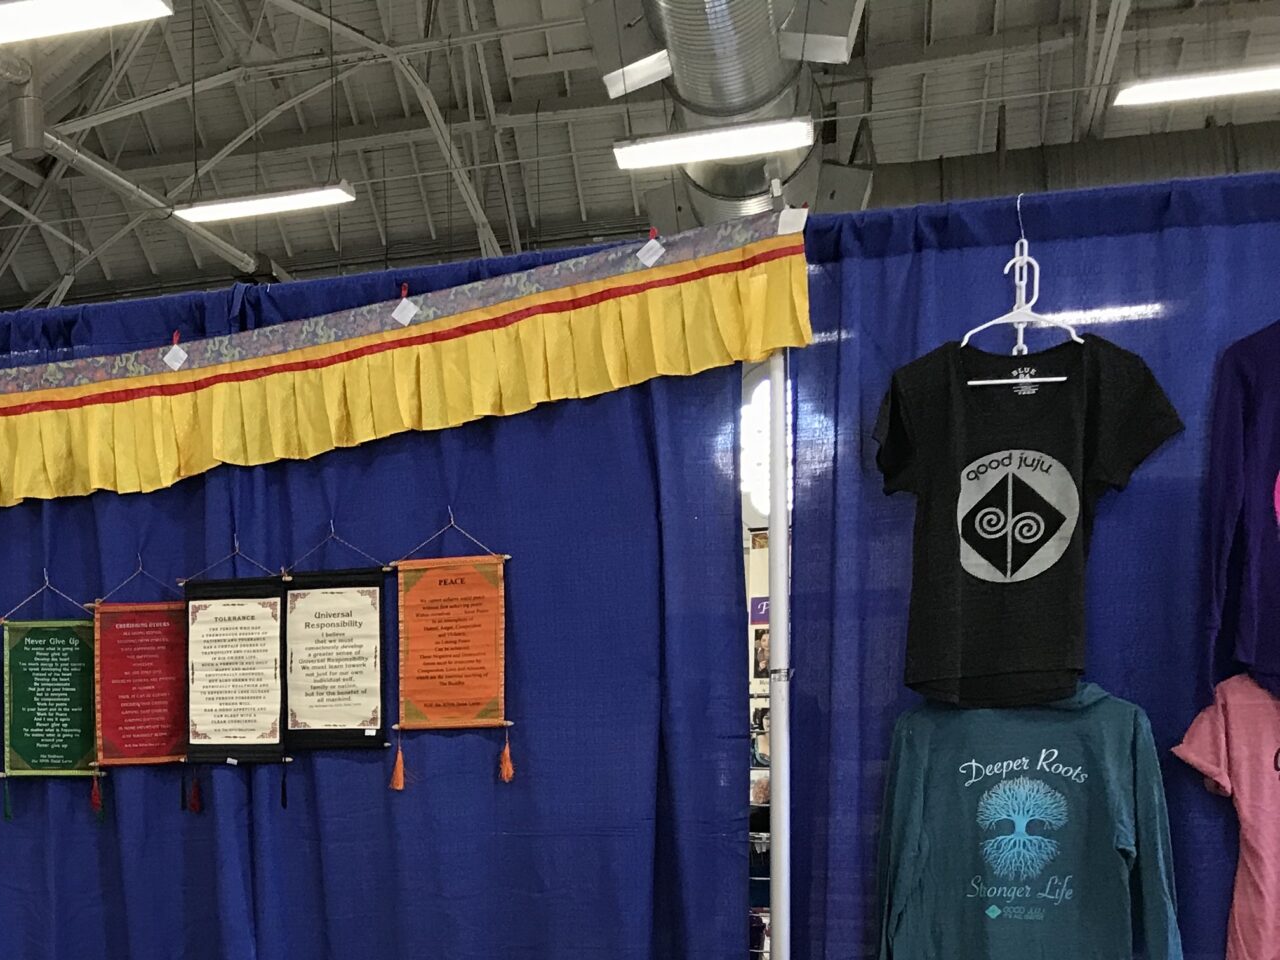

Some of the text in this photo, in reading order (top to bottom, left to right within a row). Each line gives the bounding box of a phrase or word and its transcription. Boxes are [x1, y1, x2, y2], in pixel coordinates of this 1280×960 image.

[1011, 367, 1037, 377] BLUE
[966, 453, 1053, 481] good juju
[438, 577, 466, 586] PEACE
[314, 610, 353, 619] Universal
[305, 621, 363, 630] Responsibility
[24, 637, 80, 646] Never Give Up
[958, 748, 1089, 788] Deeper Roots
[1037, 875, 1074, 905] Life
